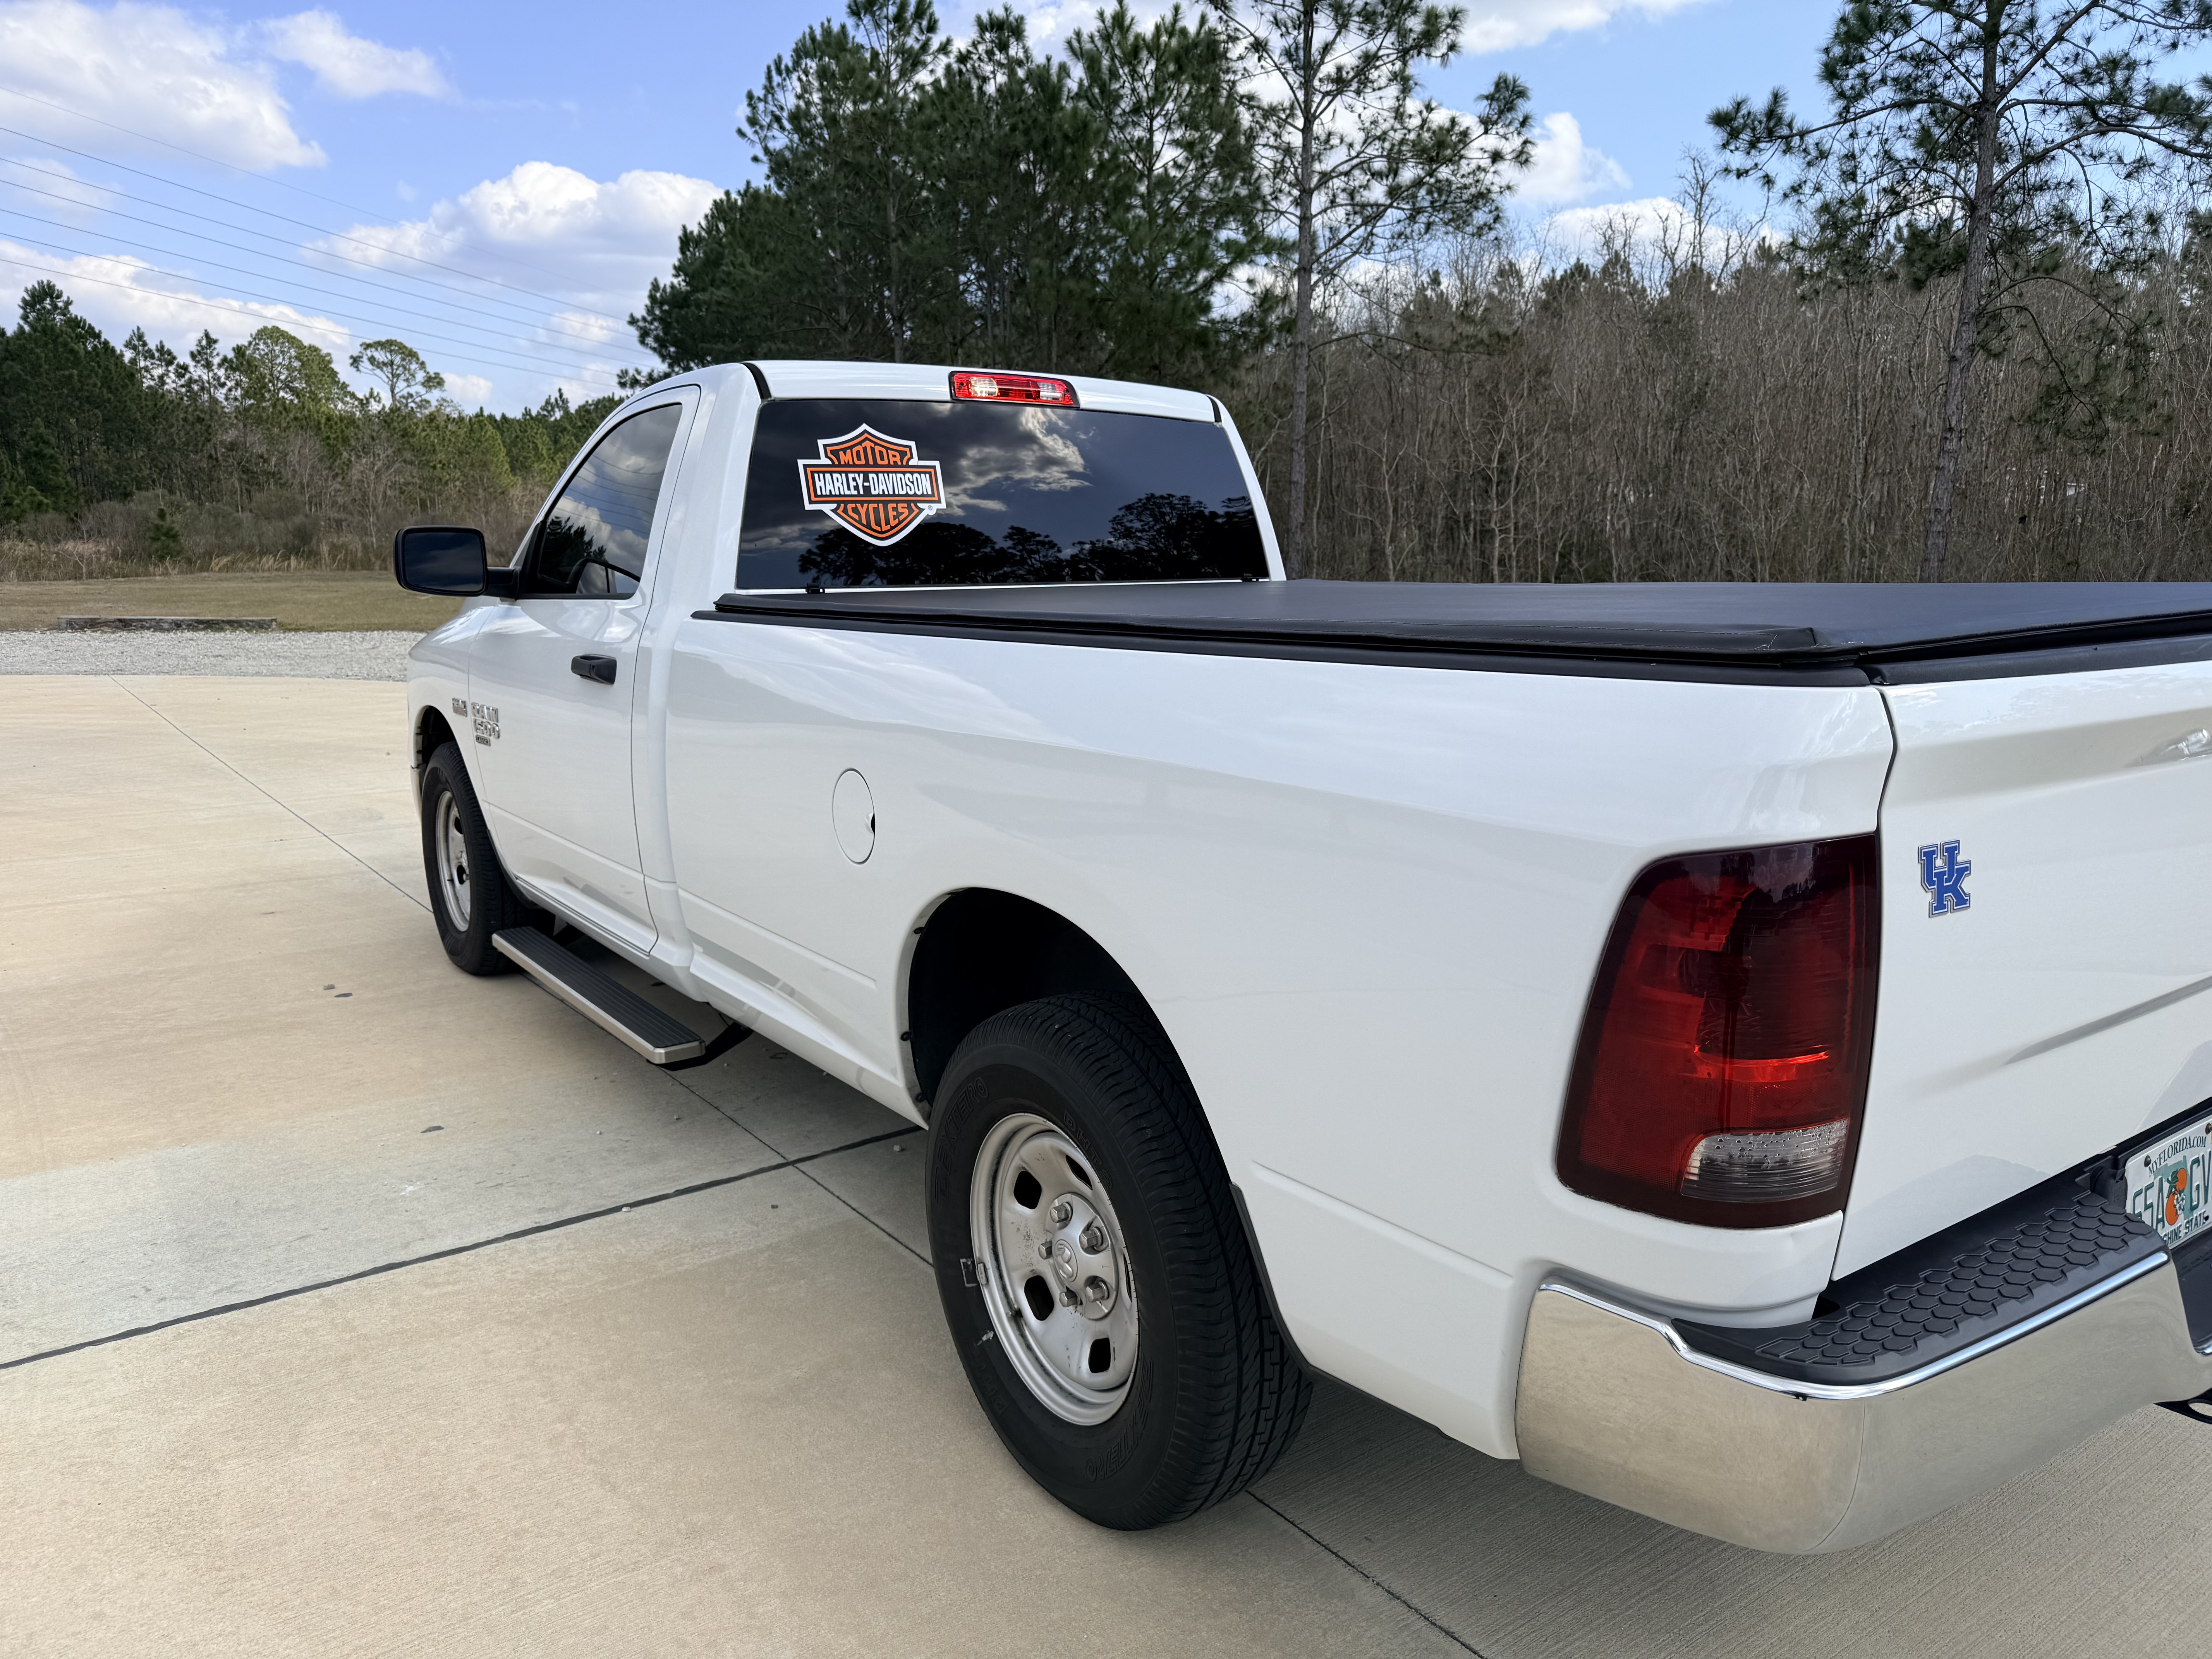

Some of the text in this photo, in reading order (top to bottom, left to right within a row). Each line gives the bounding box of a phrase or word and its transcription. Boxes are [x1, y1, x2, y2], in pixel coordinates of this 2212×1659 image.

[839, 440, 901, 465] MOTOR
[814, 473, 932, 495] HARLEY-DAVIDSON
[847, 503, 909, 531] CYCLES
[1918, 839, 1971, 918] UK
[934, 1077, 989, 1203] DEXTERO
[2148, 1135, 2207, 1177] MYFLORIDA.COM
[2185, 1210, 2206, 1235] STATE
